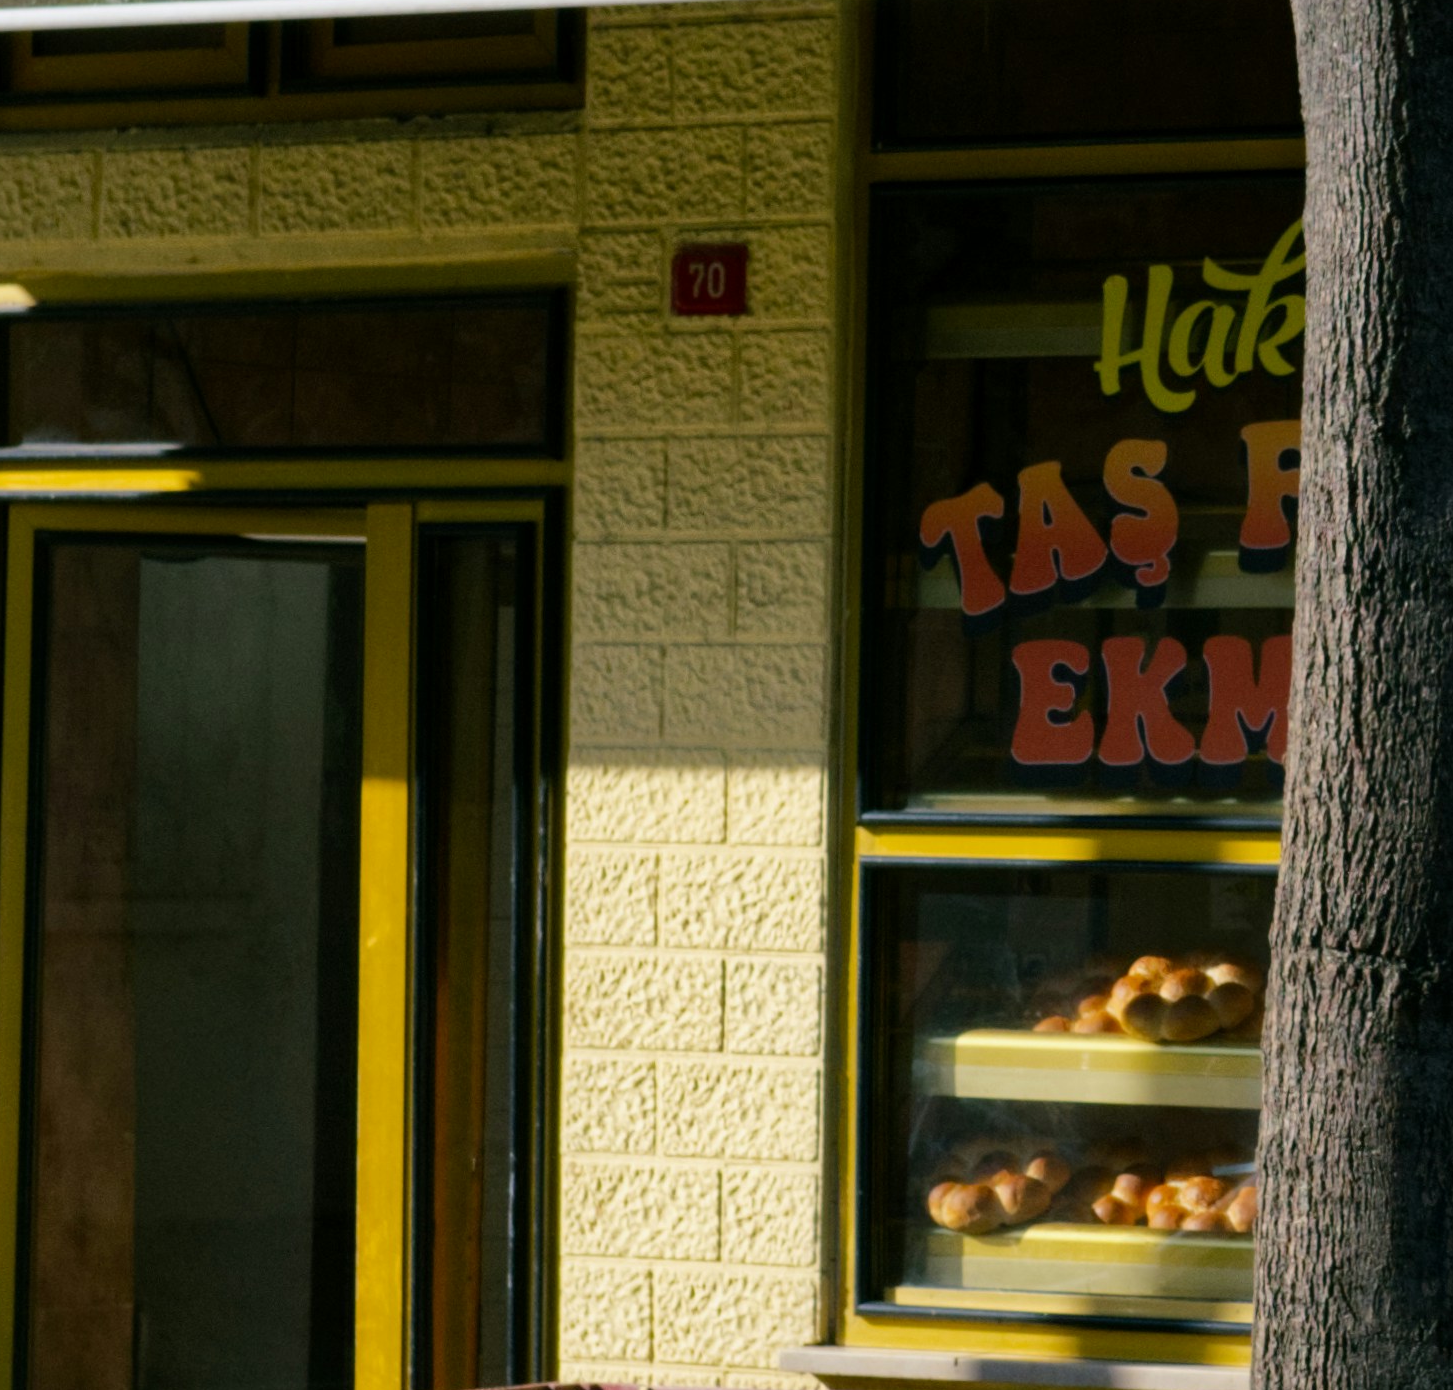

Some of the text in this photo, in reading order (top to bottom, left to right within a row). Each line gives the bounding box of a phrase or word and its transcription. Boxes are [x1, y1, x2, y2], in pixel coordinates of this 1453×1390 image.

[689, 261, 725, 298] 70
[1094, 218, 1307, 413] Hak
[920, 438, 1180, 617] TAŞ
[1011, 637, 1295, 766] EKM
